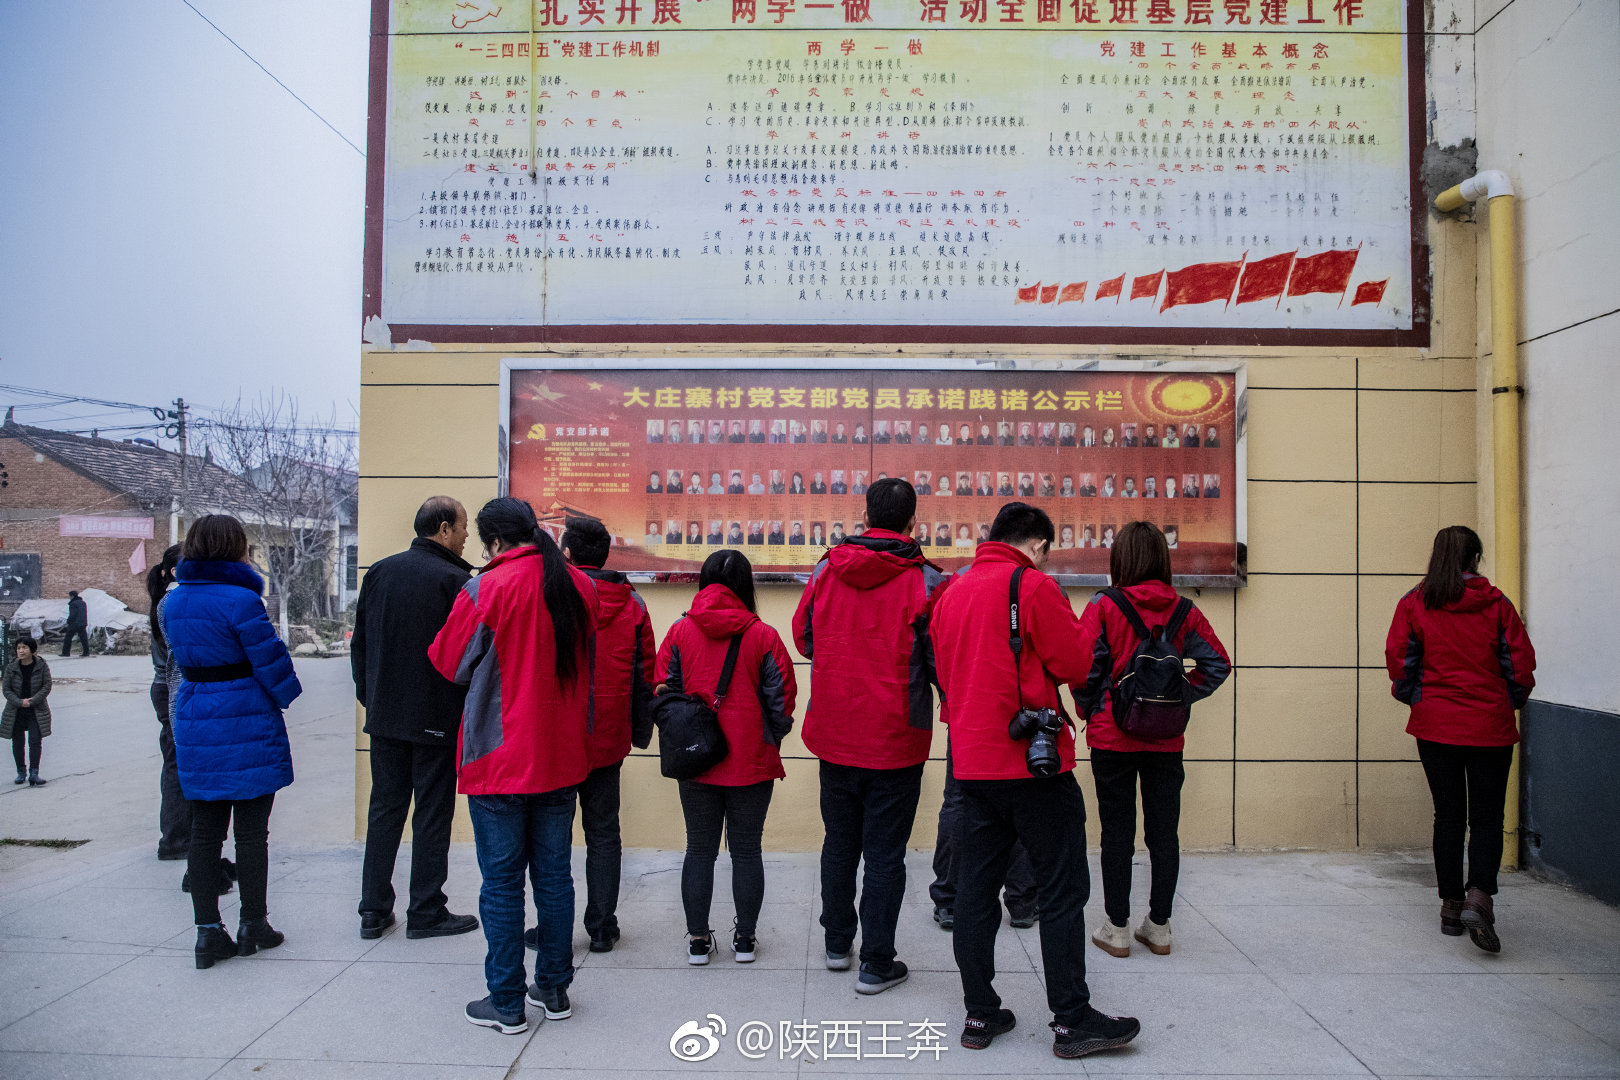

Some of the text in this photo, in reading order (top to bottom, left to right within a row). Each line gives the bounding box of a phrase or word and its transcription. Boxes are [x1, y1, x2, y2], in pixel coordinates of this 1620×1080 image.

[806, 40, 924, 56] 两学一做
[1100, 42, 1329, 58] 党建工作基本概念
[623, 386, 1124, 411] 大庄寨村党支部党员承诺践诺公示栏
[555, 427, 610, 437] 党支部承诺
